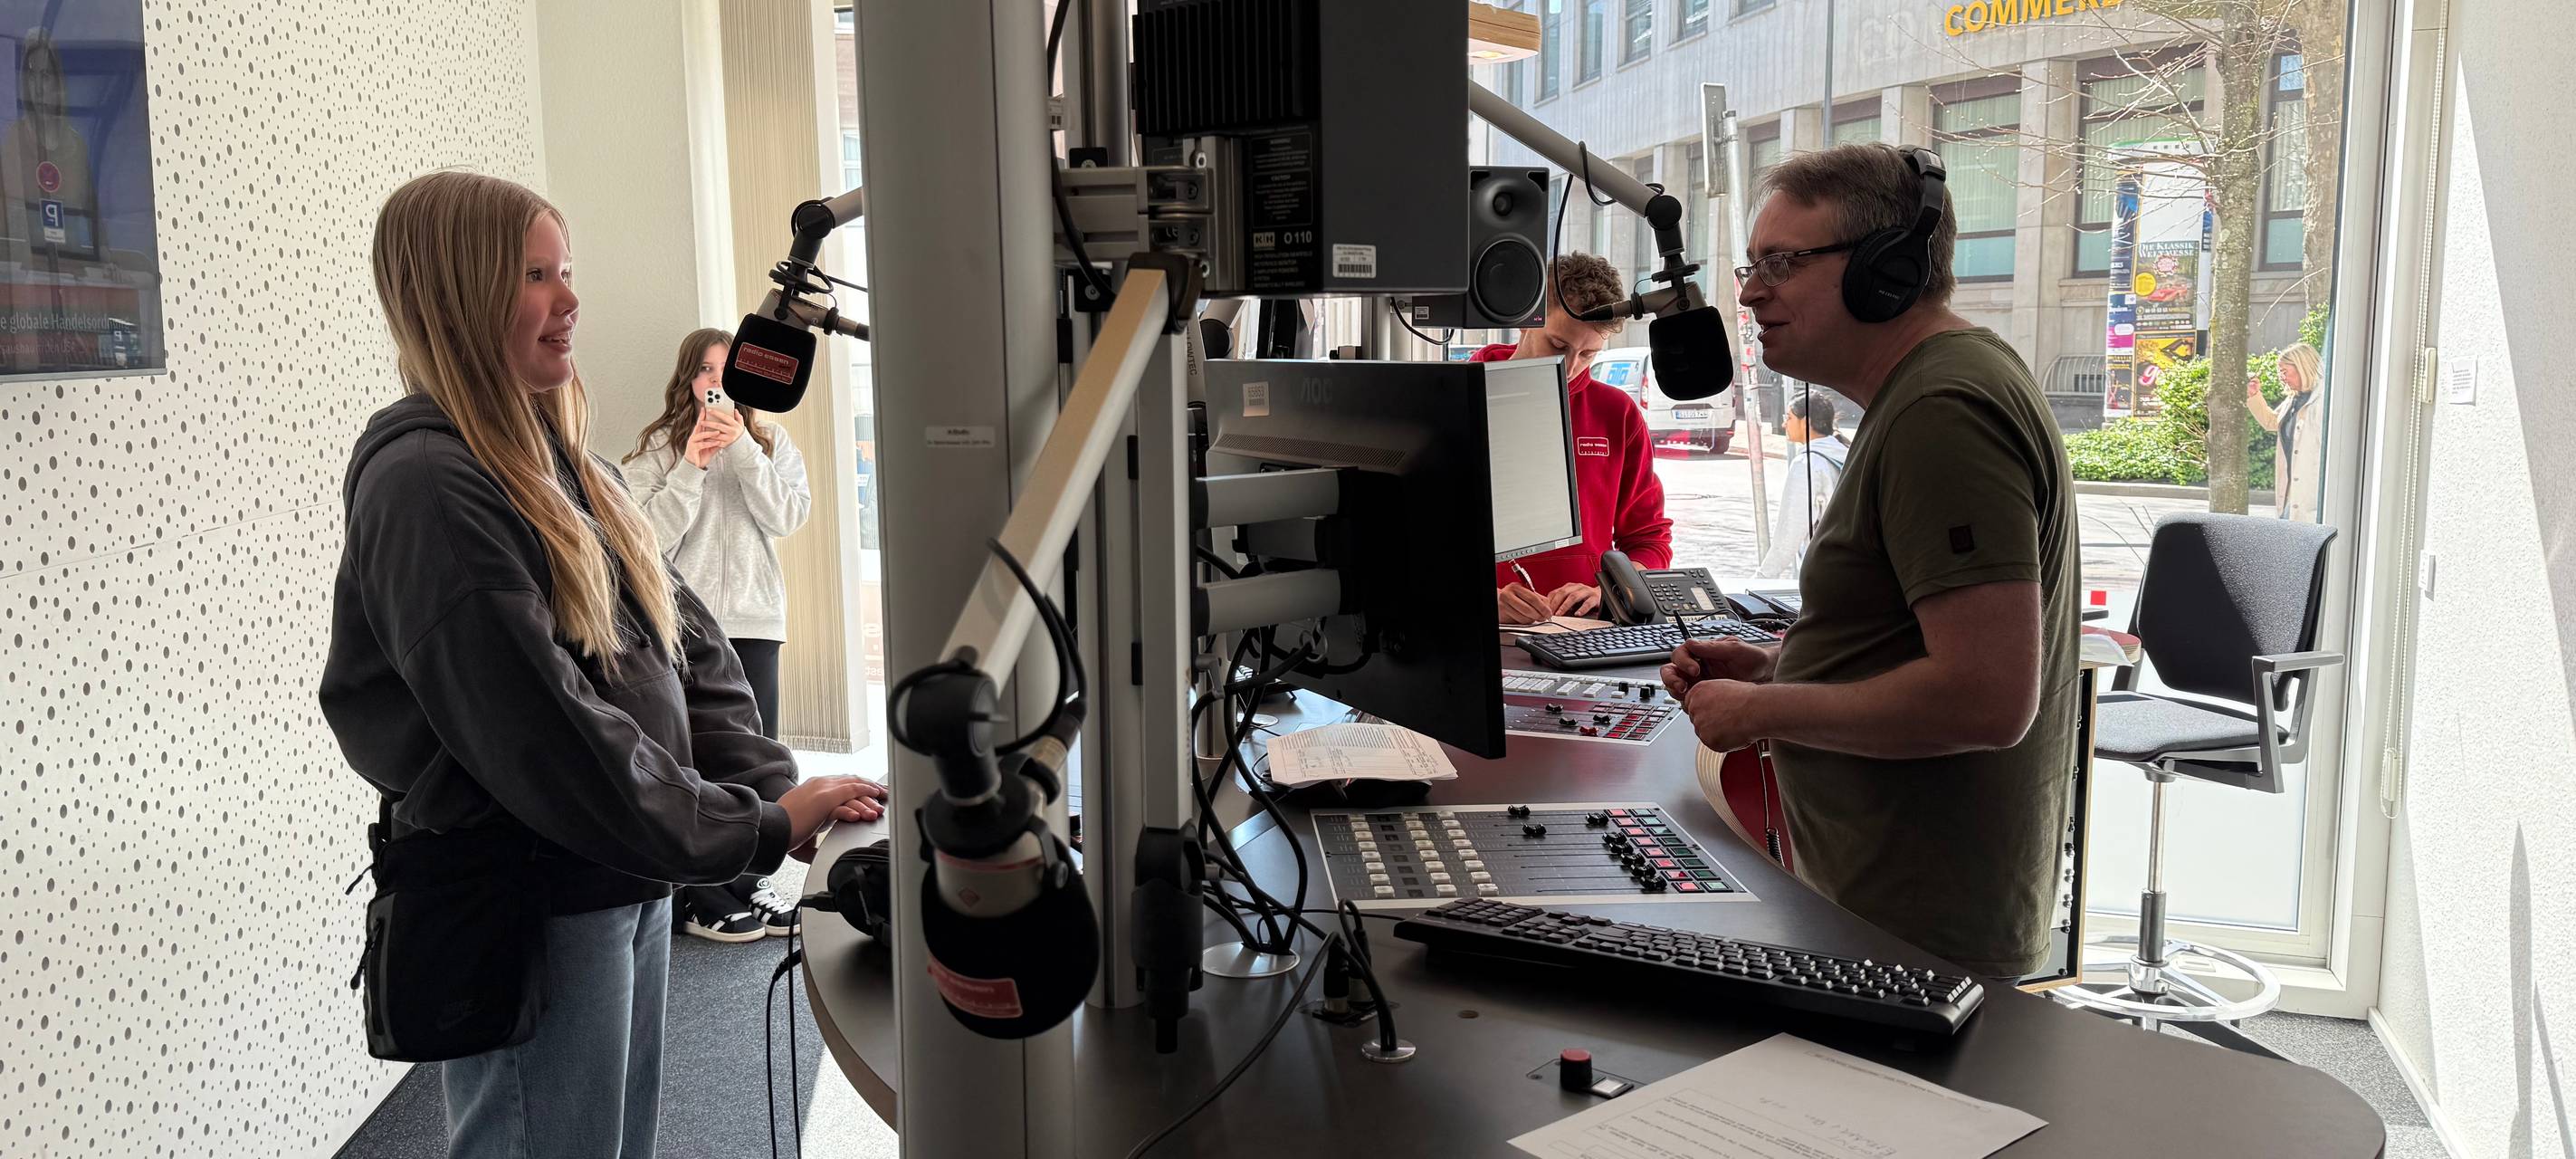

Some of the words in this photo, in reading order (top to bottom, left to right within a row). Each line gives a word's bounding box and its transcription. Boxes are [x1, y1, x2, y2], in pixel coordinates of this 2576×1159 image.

[1943, 0, 2120, 36] COMME
[1294, 230, 1312, 244] 110
[2156, 242, 2194, 250] KLASSIK
[10, 312, 49, 333] globale
[743, 347, 763, 357] radio
[764, 354, 789, 365] essen
